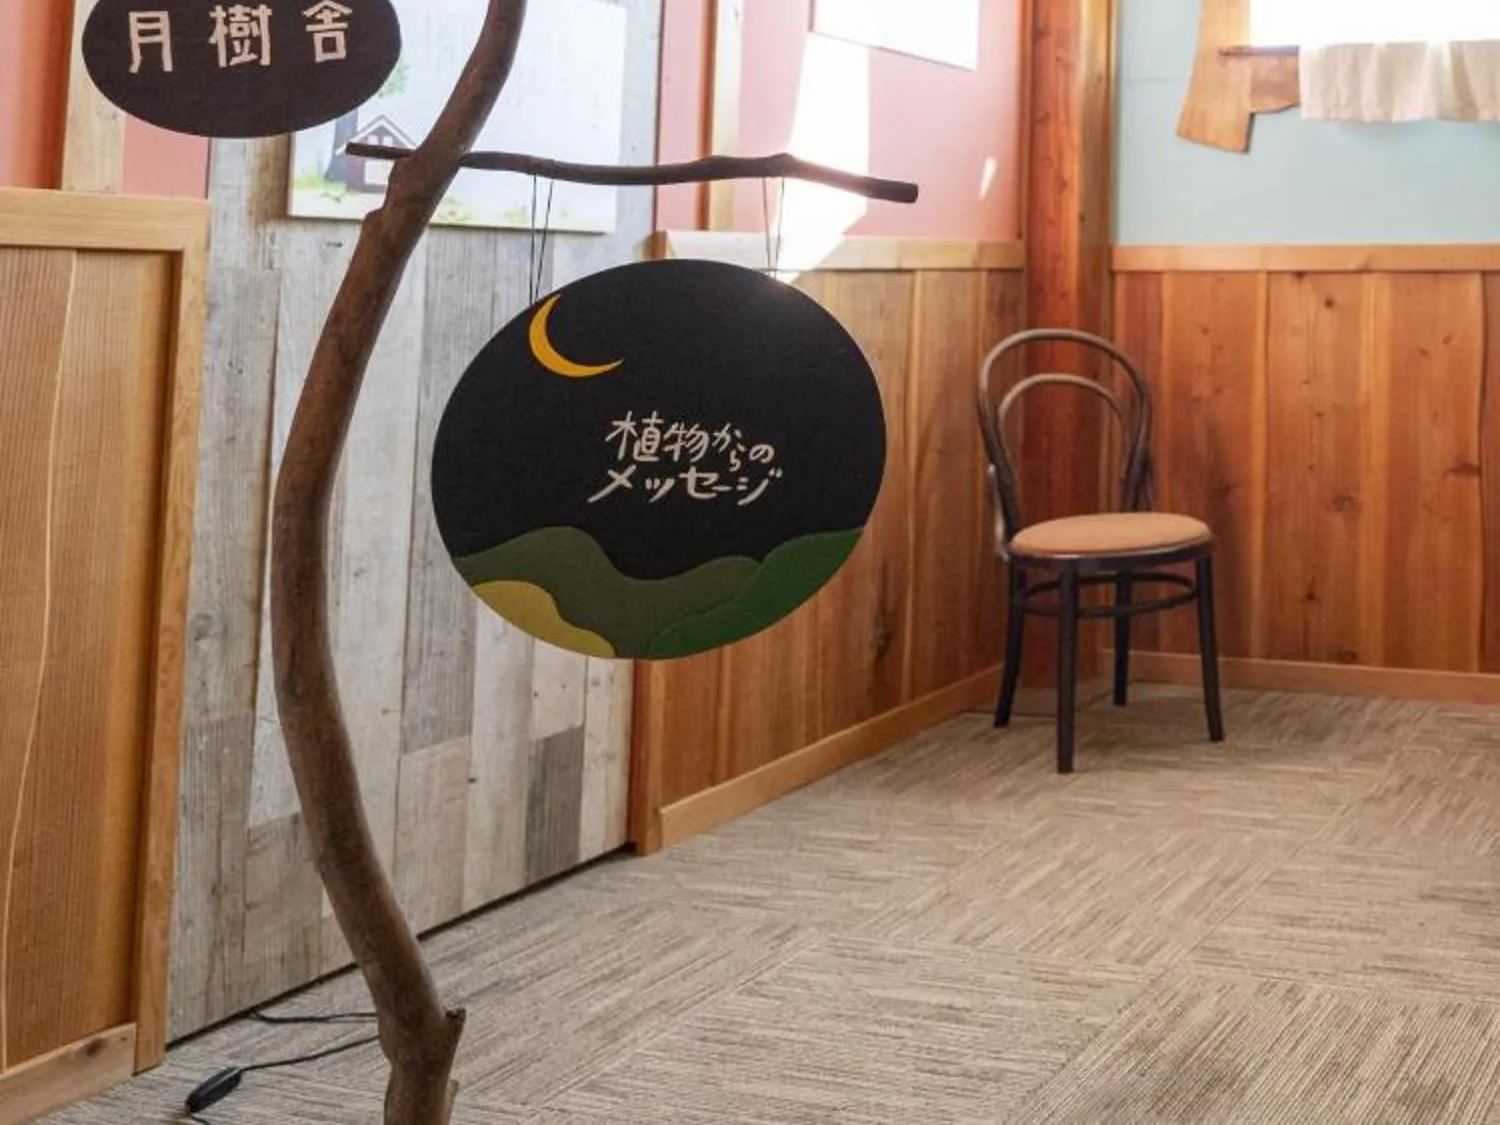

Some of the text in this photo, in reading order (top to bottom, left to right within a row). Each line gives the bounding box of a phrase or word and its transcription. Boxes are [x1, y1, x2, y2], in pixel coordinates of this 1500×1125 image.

[605, 410, 775, 472] 植物からの
[586, 464, 784, 507] メッセージ
